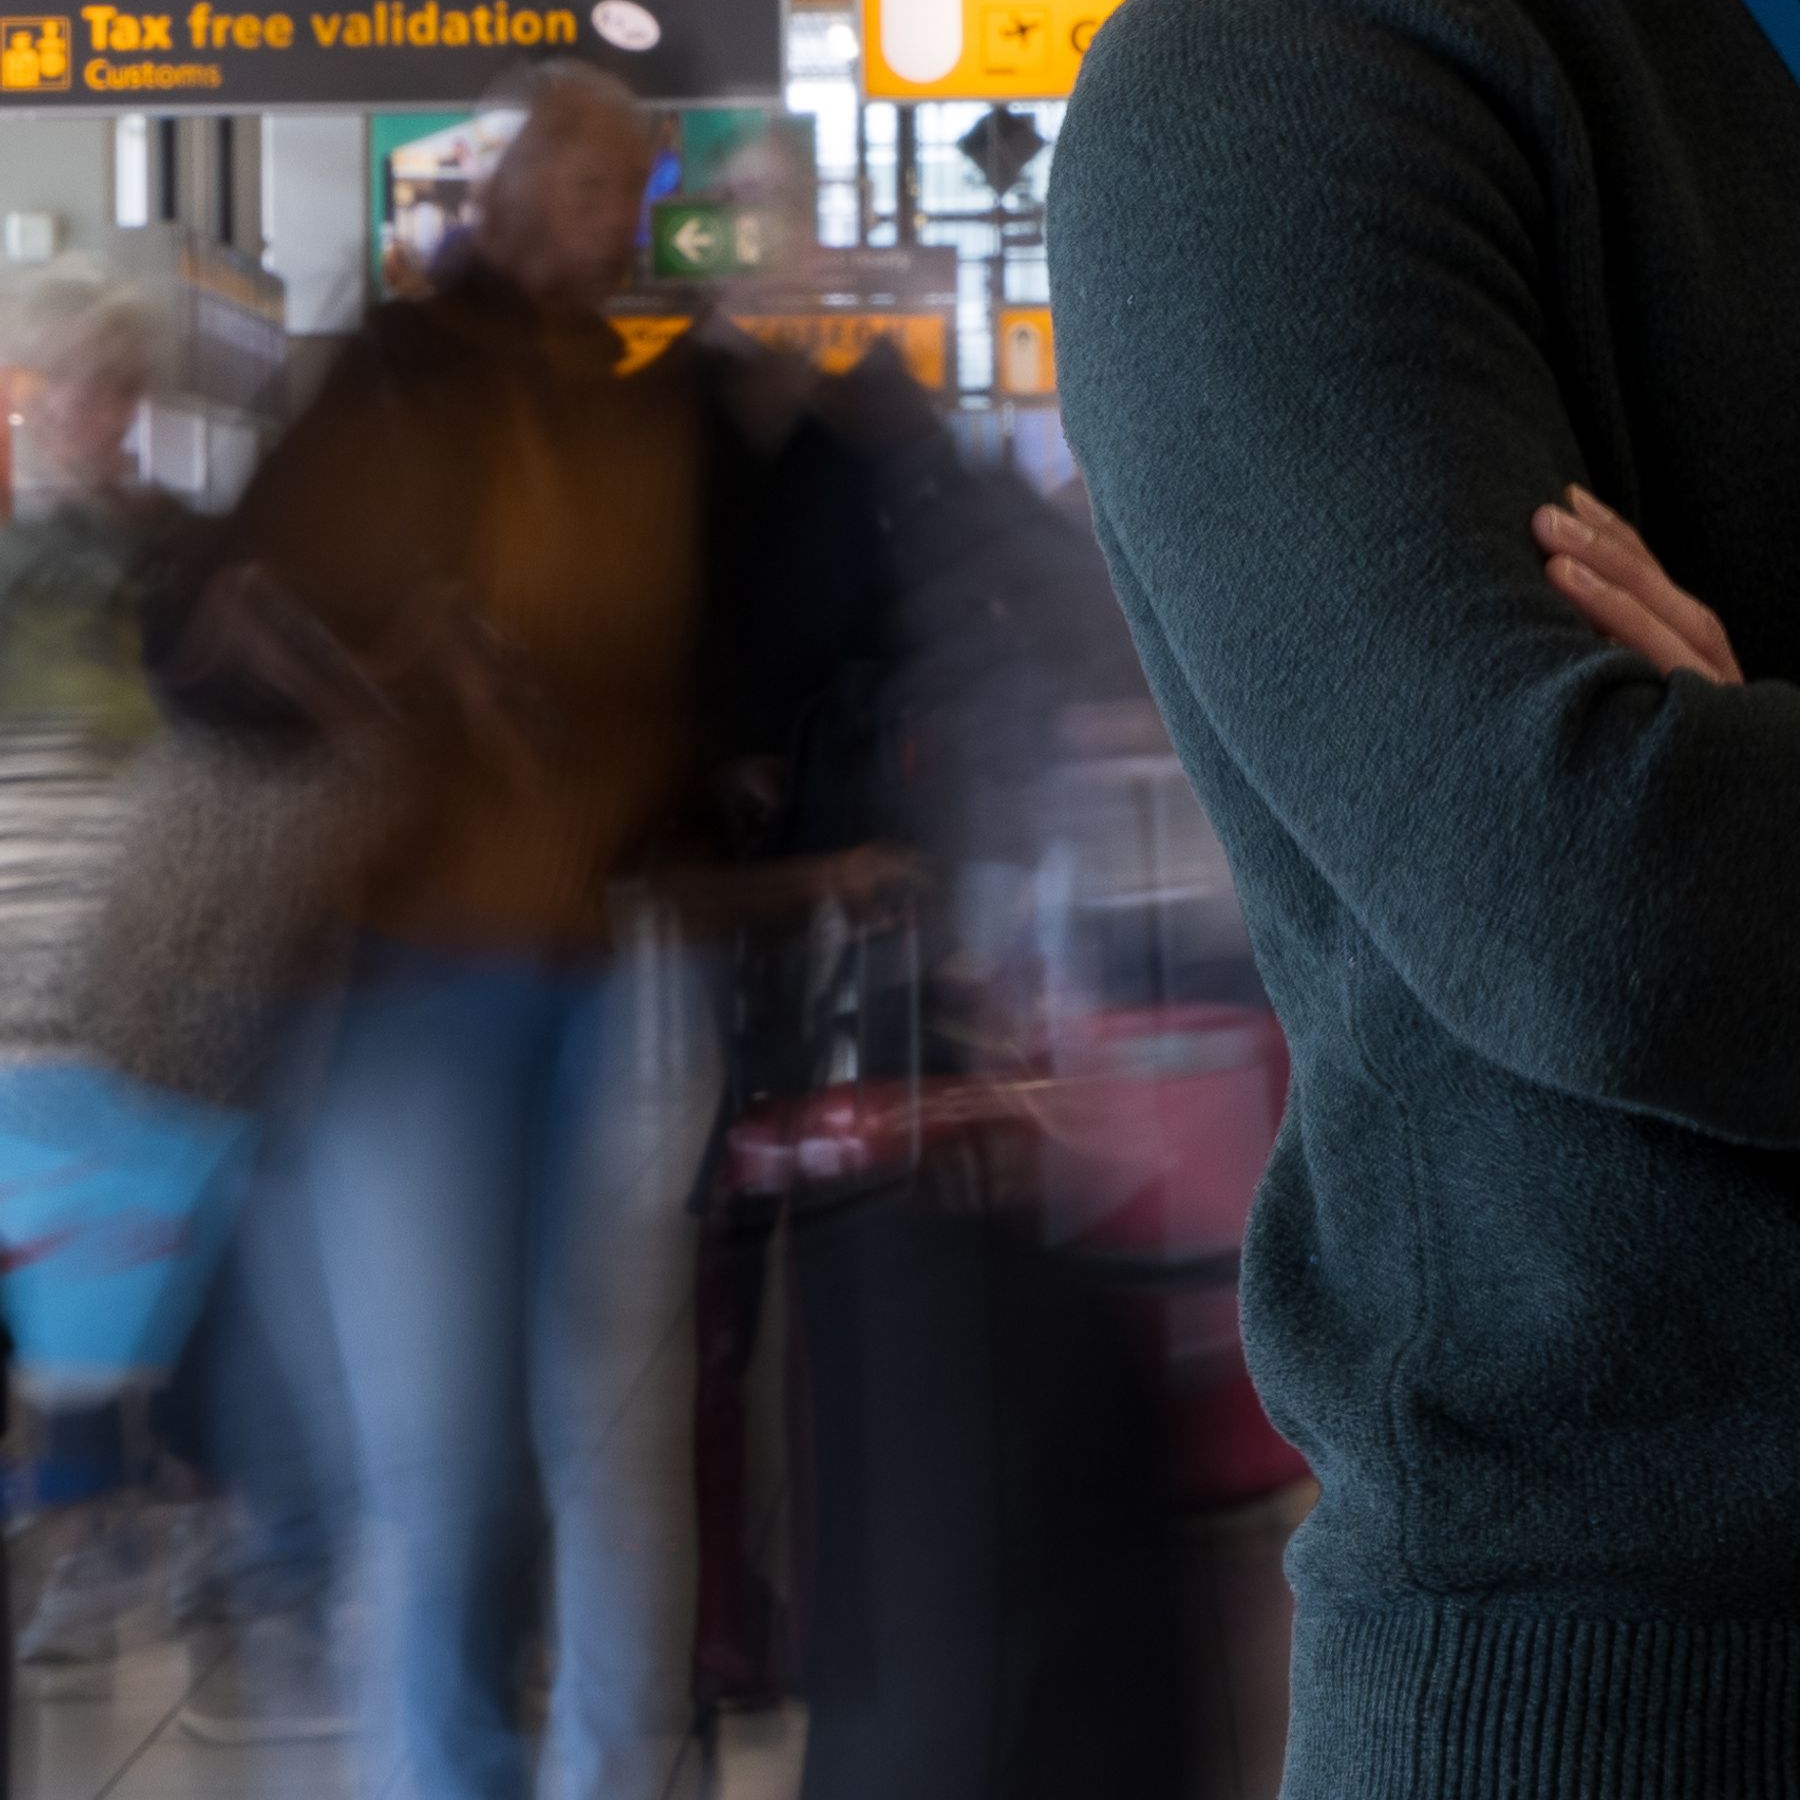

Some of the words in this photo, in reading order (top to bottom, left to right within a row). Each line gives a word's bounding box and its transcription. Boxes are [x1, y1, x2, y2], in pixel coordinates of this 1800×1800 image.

[82, 5, 171, 50] Tax
[187, 2, 293, 48] free
[311, 0, 576, 46] validation
[84, 58, 222, 90] Customs
